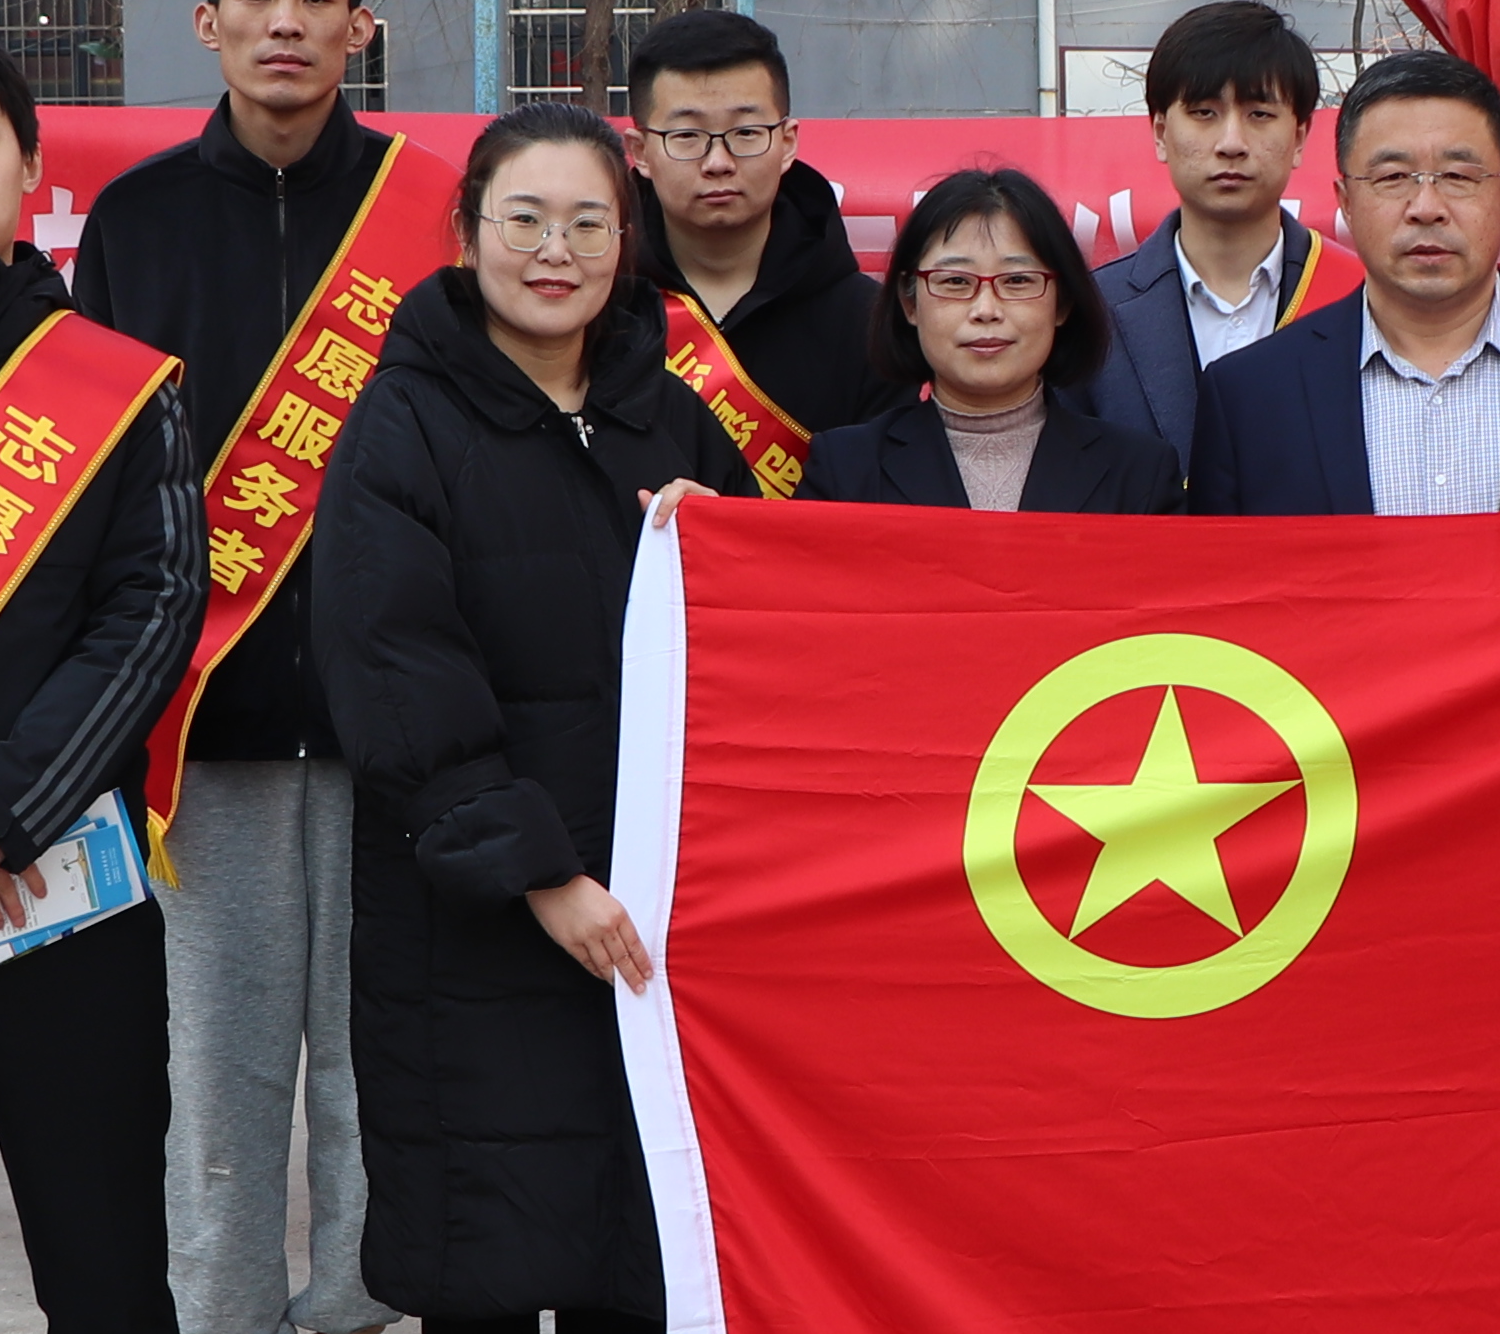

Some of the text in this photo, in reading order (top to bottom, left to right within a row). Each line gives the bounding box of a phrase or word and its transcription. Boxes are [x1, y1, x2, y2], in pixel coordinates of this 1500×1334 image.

[207, 267, 403, 596] 志愿服务者
